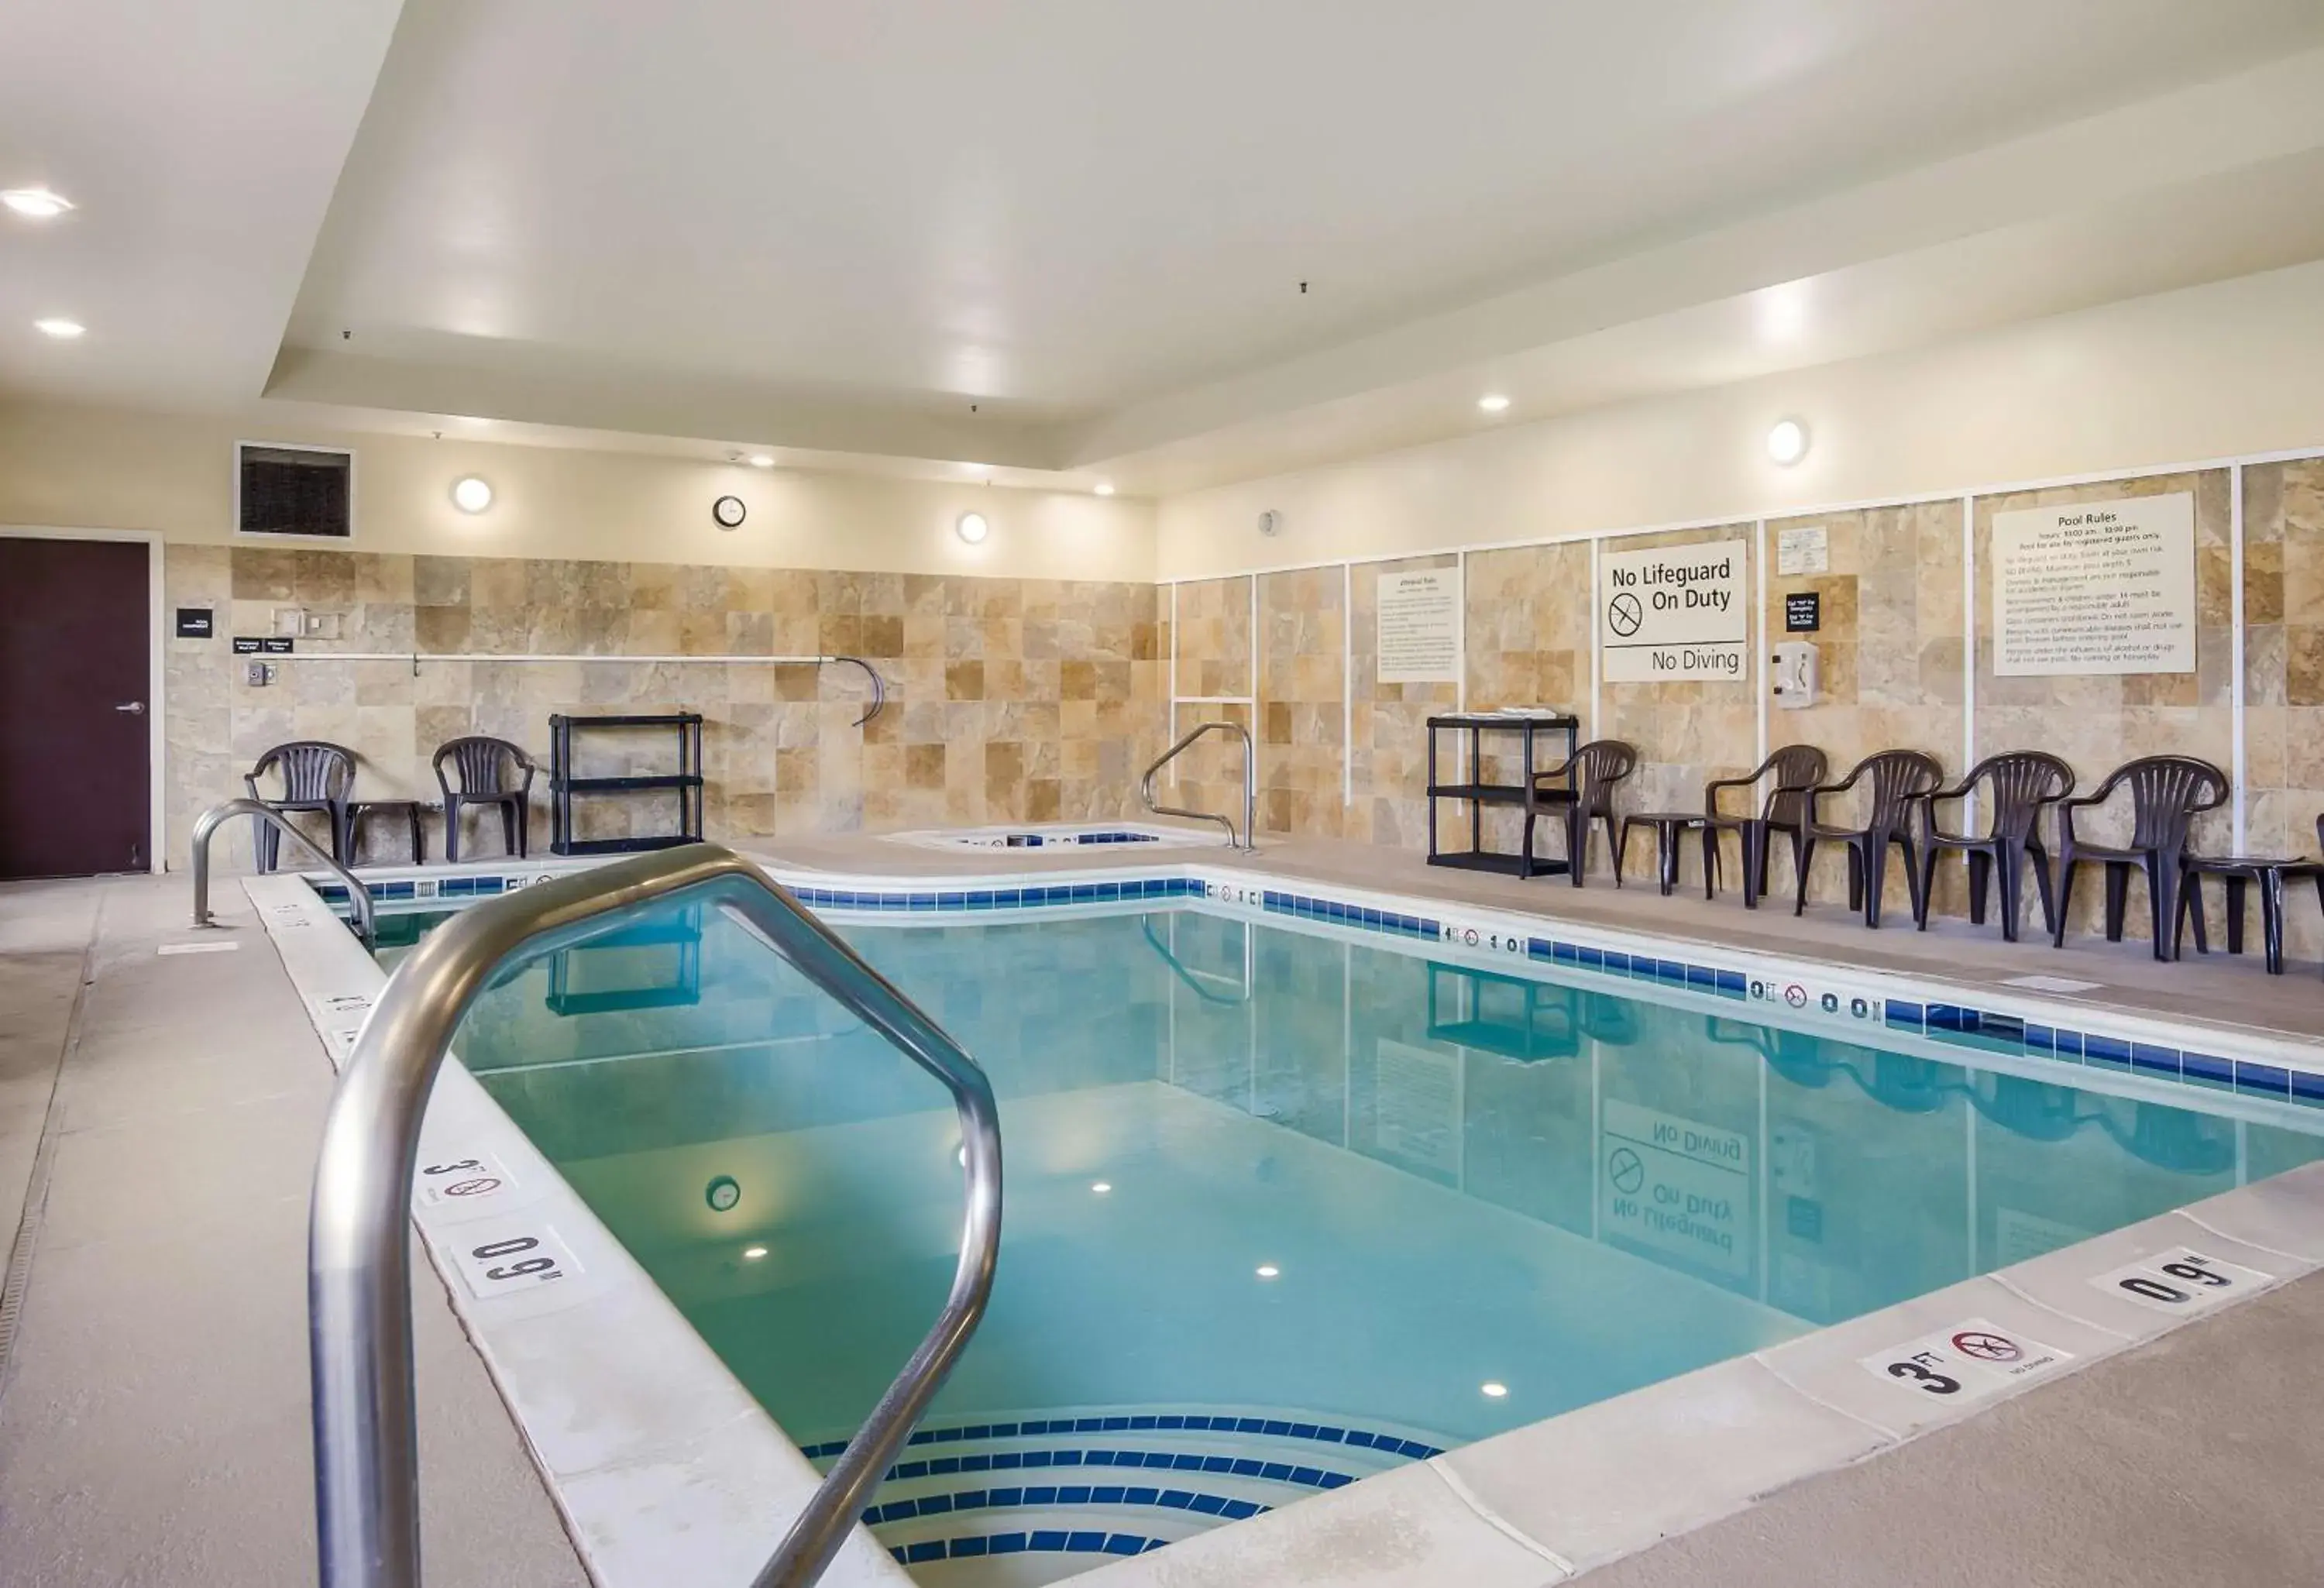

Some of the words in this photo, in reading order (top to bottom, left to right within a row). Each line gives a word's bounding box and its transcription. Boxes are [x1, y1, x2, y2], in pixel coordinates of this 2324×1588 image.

[2058, 515, 2083, 528] Pool
[2086, 512, 2117, 524] Rules
[1612, 569, 1637, 586] No
[1642, 557, 1731, 587] Lifeguard
[1652, 591, 1678, 610] On
[1685, 589, 1732, 612] Duty
[1652, 651, 1677, 670] No
[1683, 649, 1740, 674] Diving
[423, 1159, 480, 1175] 3
[1911, 1351, 1944, 1368] FT
[1887, 1362, 1961, 1394] 3
